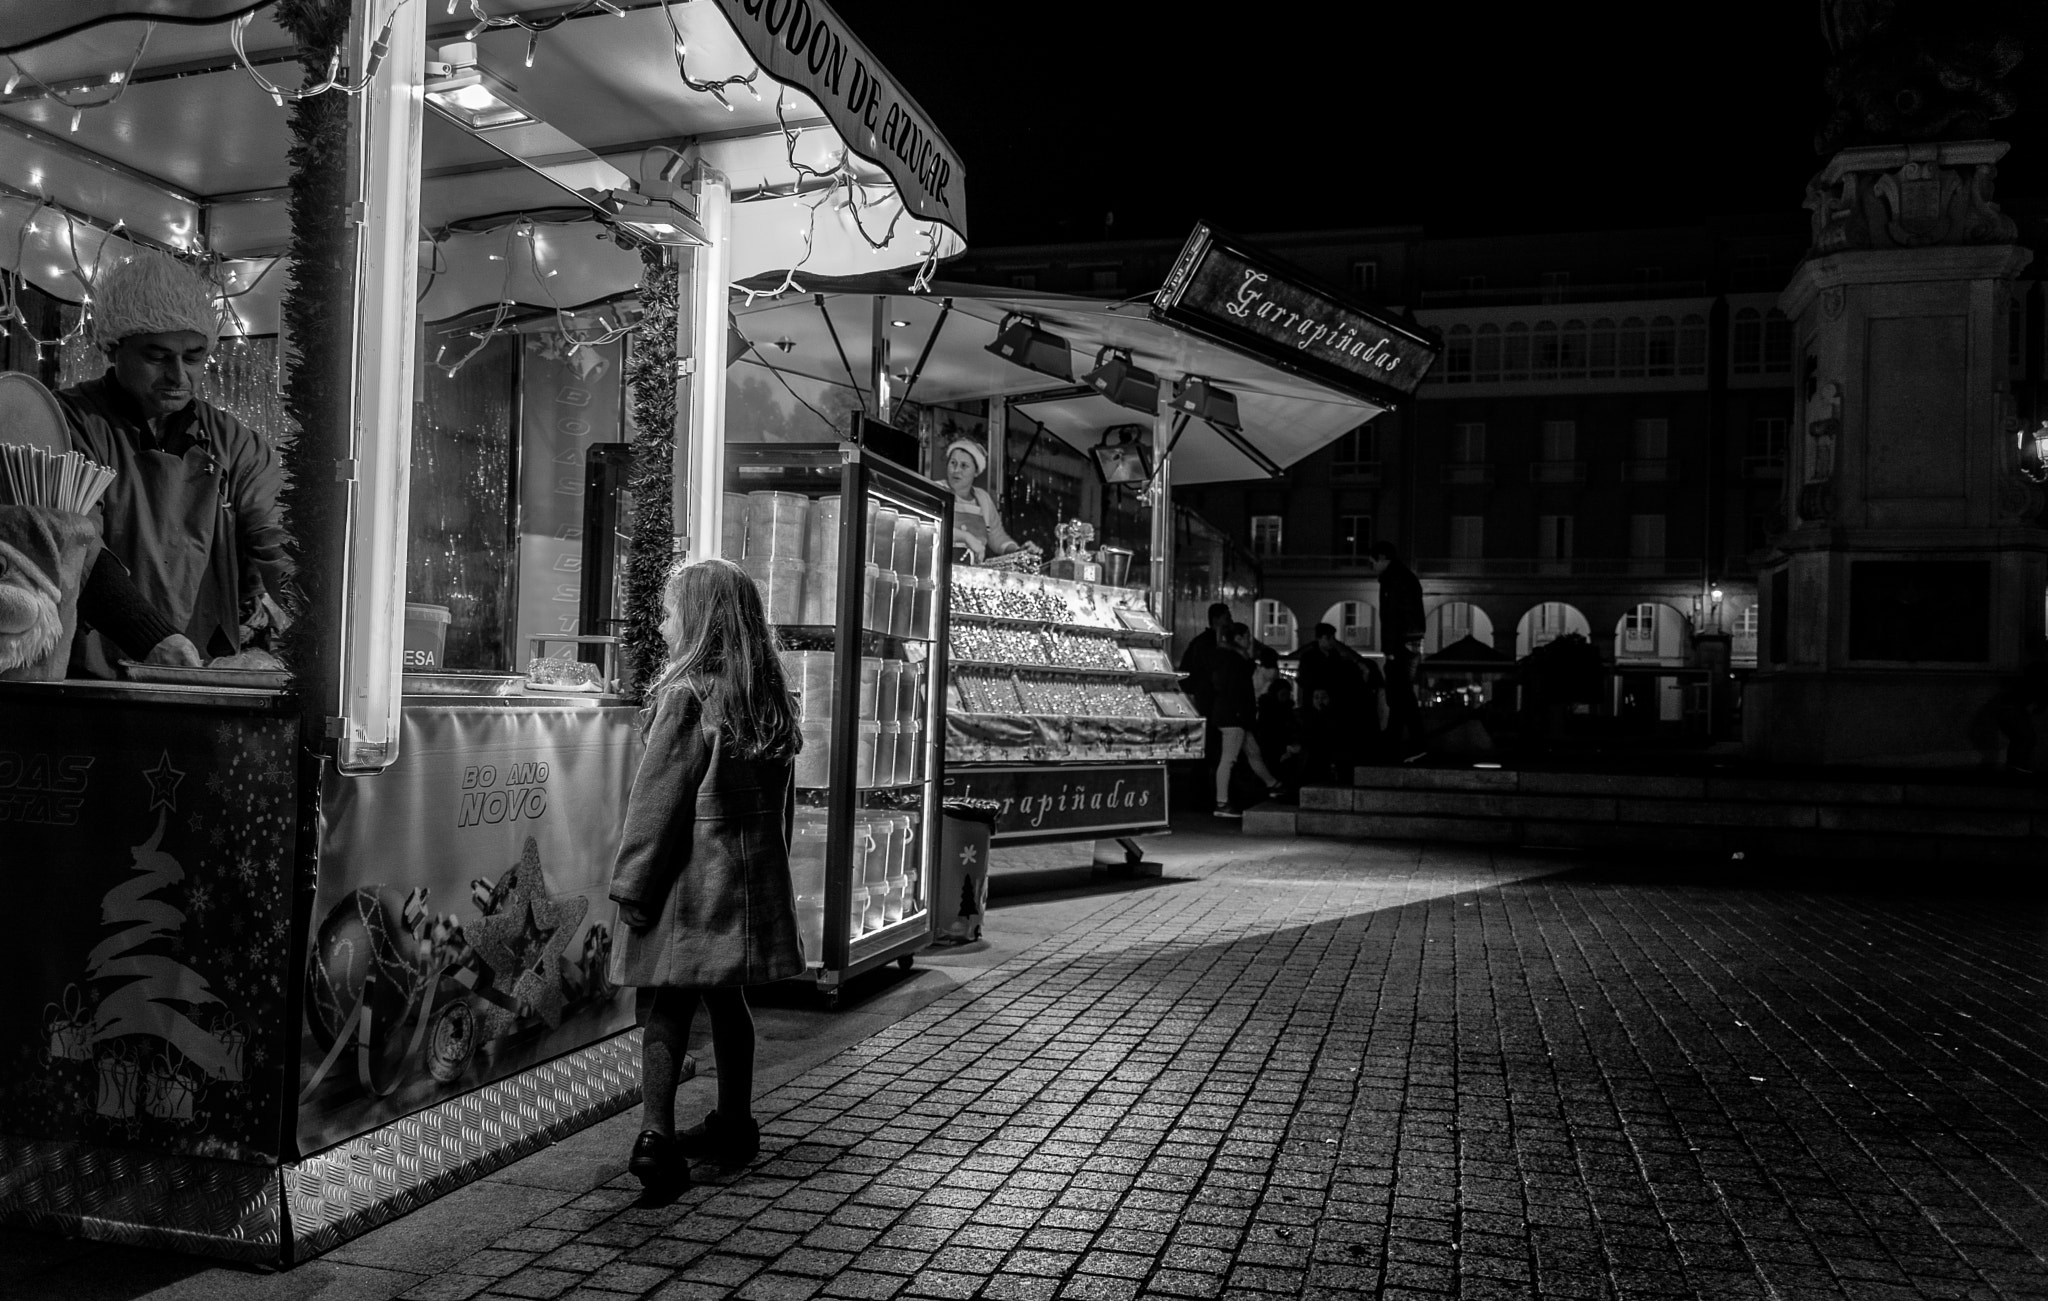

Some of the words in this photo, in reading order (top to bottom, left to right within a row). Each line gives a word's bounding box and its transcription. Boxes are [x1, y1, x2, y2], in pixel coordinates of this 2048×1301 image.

[848, 58, 881, 132] DE
[882, 102, 950, 208] AZUCAR
[1226, 268, 1401, 372] Garrapiñadas
[462, 765, 497, 789] BO
[506, 762, 549, 786] ANO
[458, 787, 547, 827] NOVO
[944, 777, 1150, 827] rapiñadas
